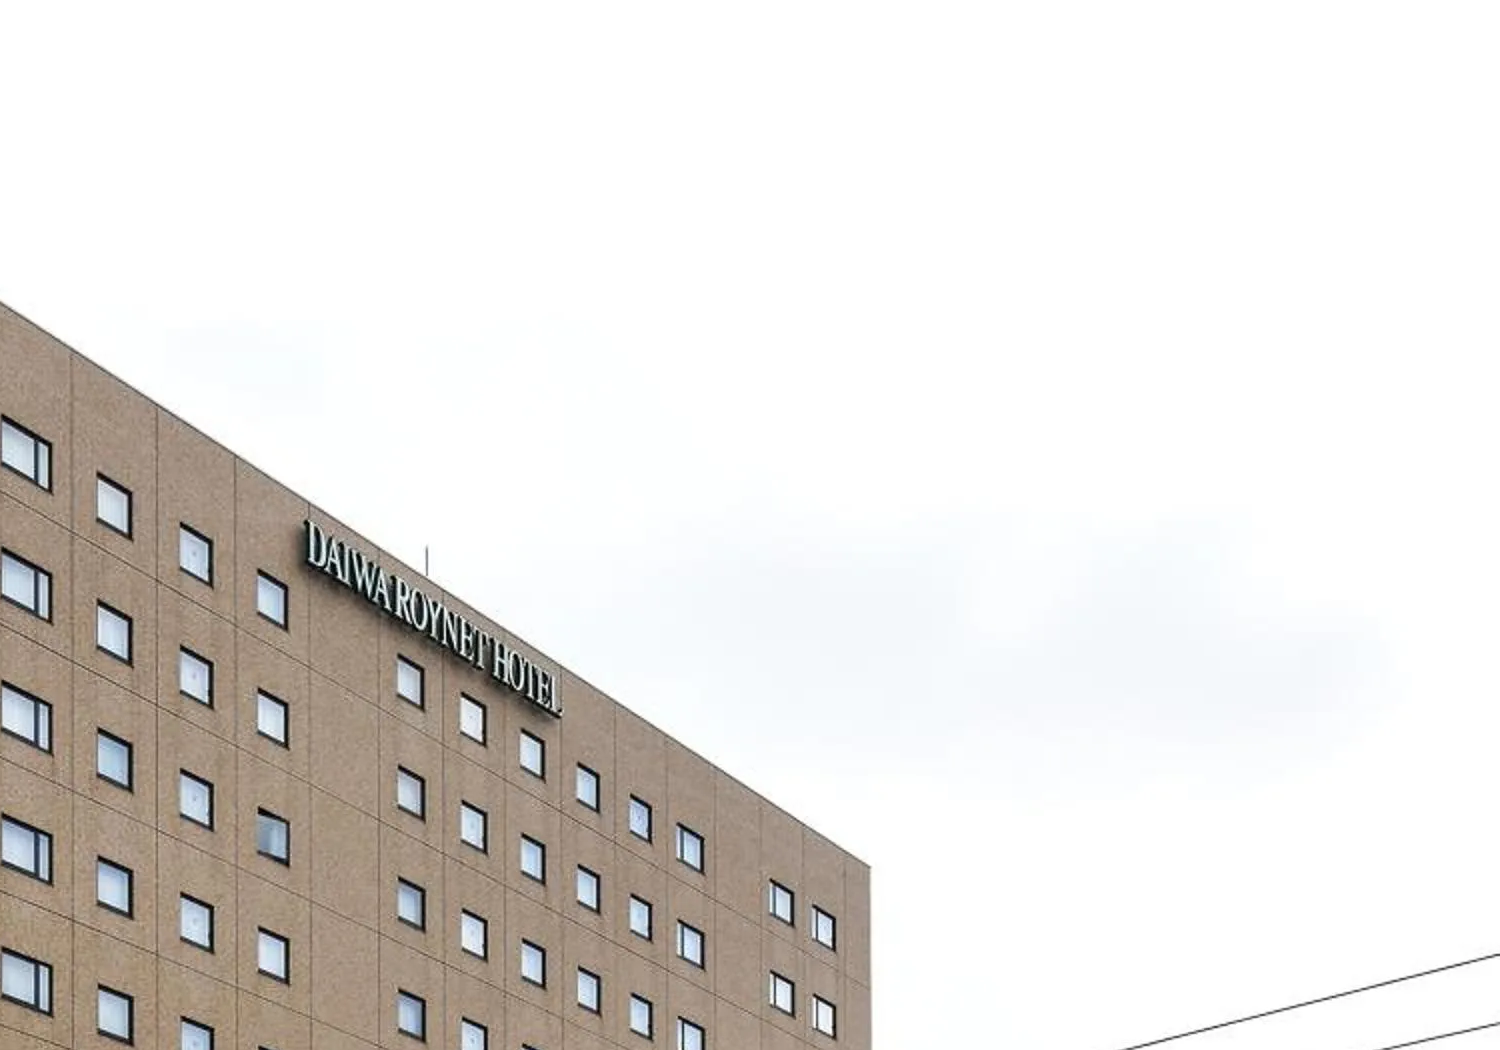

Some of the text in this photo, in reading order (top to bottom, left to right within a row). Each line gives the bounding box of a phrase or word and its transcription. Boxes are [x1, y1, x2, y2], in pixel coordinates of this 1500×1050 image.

[304, 520, 563, 718] DAIWA ROYNET HOTEL
